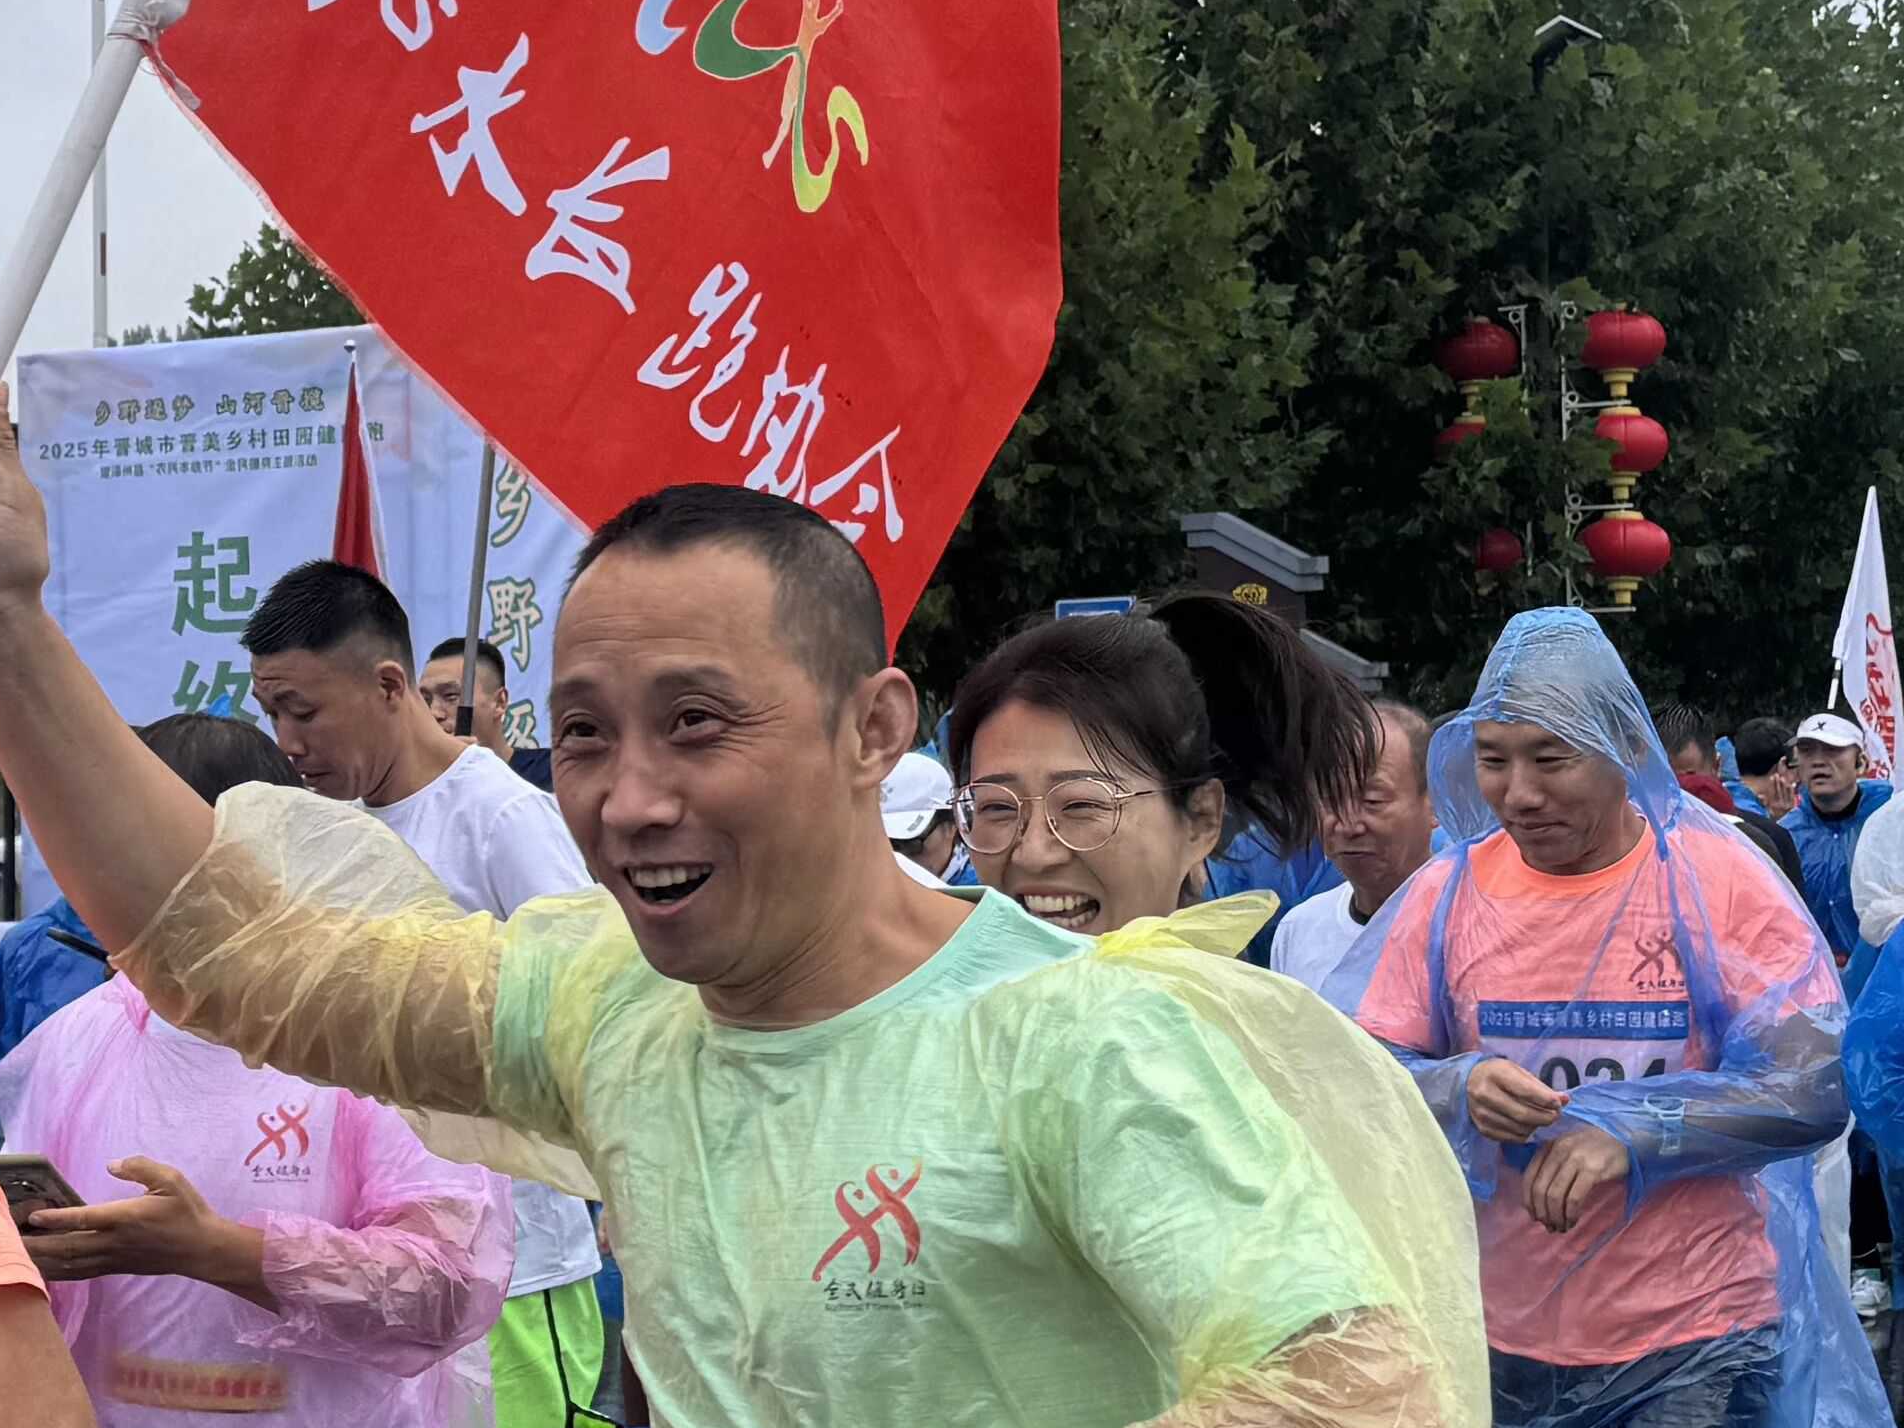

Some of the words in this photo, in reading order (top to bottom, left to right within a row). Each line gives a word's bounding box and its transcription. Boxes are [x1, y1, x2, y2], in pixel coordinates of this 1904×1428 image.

[39, 422, 385, 460] 2025年晋城市晋美乡村田园健跑
